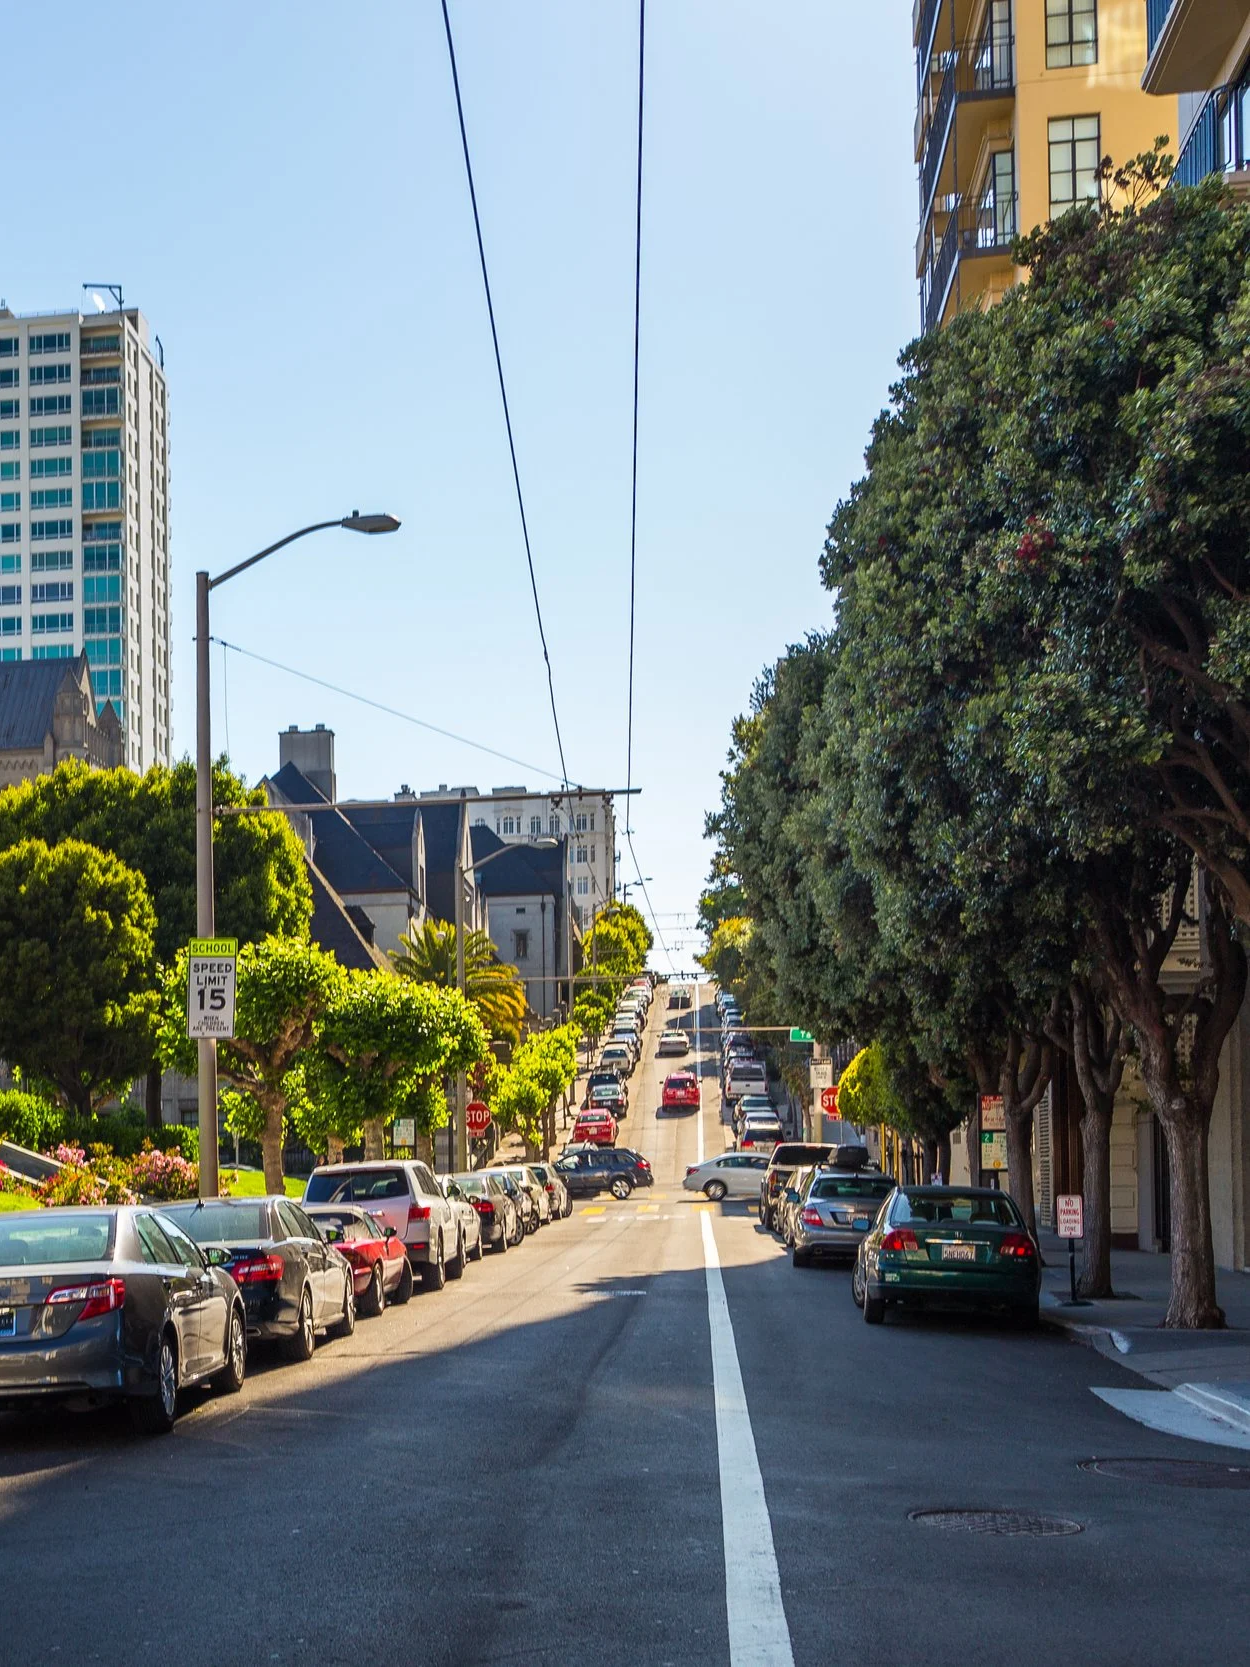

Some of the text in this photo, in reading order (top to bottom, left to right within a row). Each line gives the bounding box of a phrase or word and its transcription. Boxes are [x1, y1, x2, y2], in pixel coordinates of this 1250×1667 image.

[192, 943, 234, 954] SCHOOL
[193, 962, 232, 973] SPEED
[196, 975, 228, 987] LIMIT
[197, 988, 226, 1011] 15
[466, 1110, 490, 1123] STOP
[1064, 1199, 1074, 1208] NO
